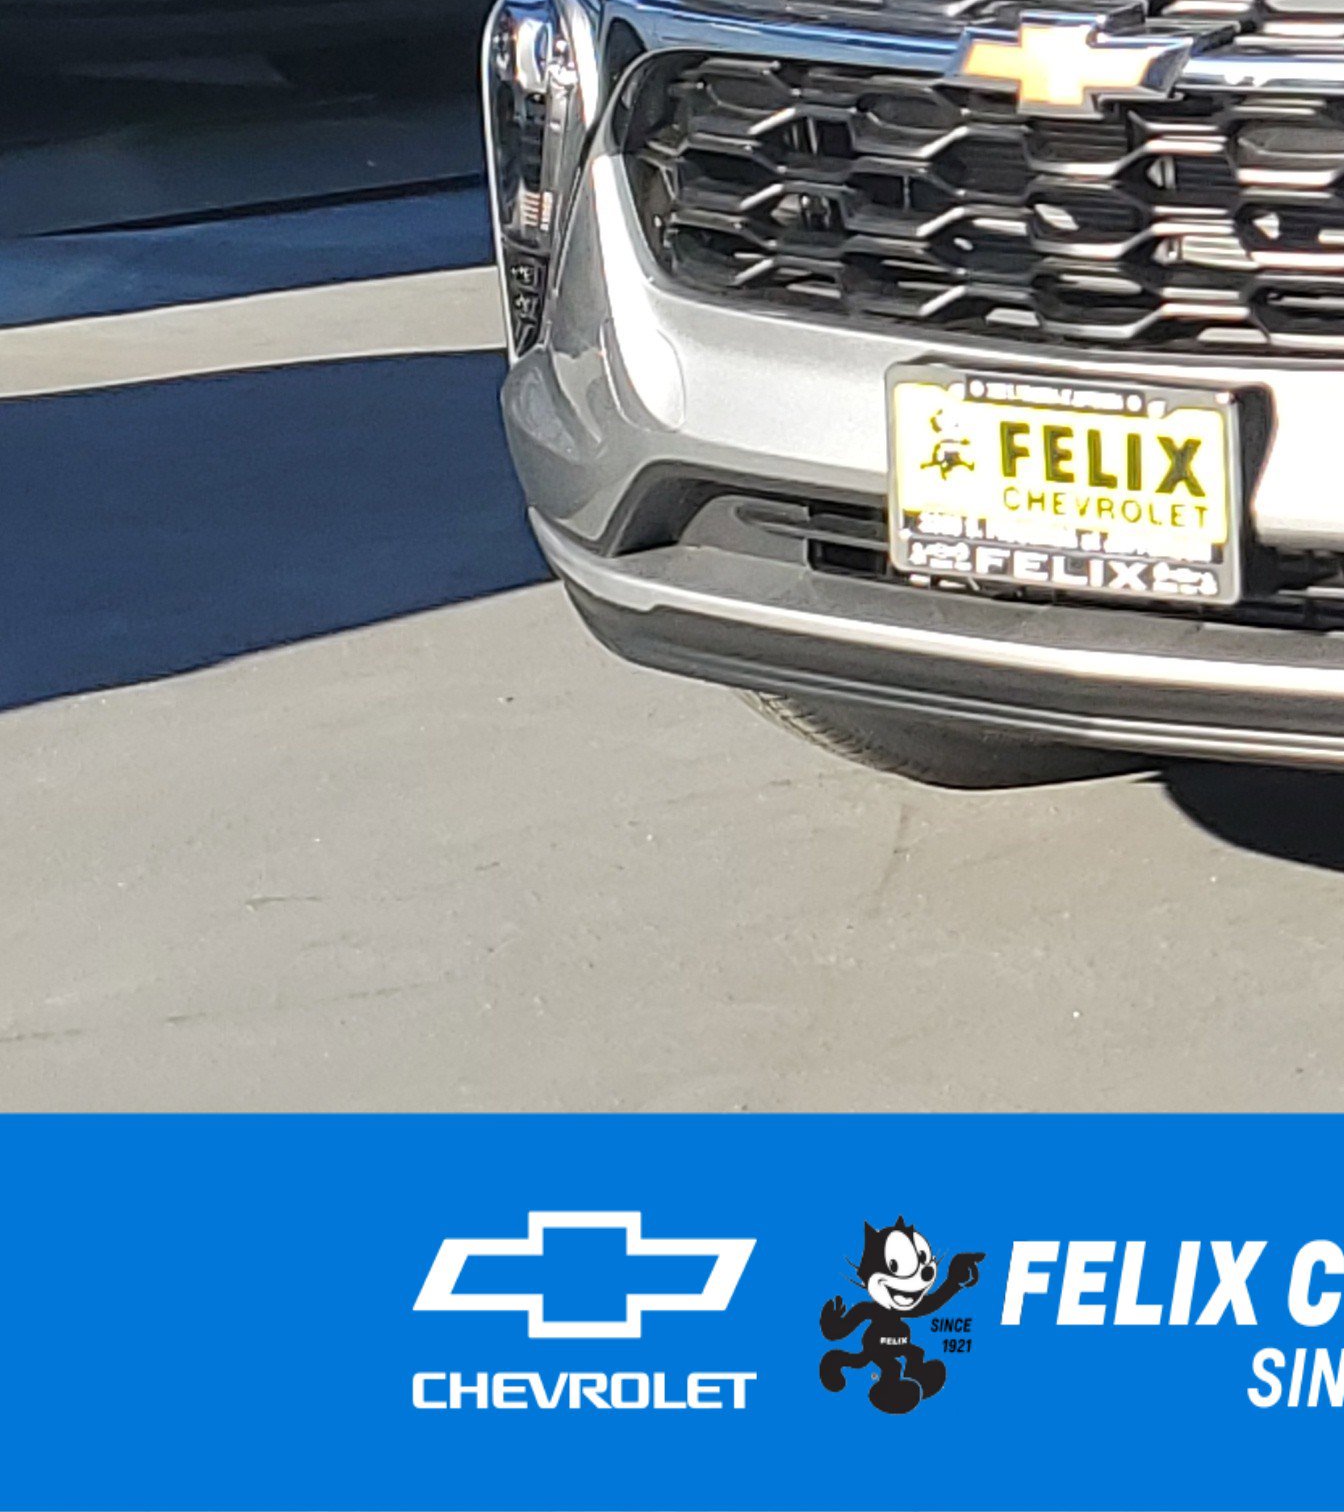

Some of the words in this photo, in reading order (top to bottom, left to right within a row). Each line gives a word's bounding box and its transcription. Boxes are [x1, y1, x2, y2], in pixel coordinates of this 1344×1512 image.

[1000, 420, 1206, 497] FELIX
[1003, 486, 1208, 529] CHEVROLET
[975, 545, 1149, 591] FELIX
